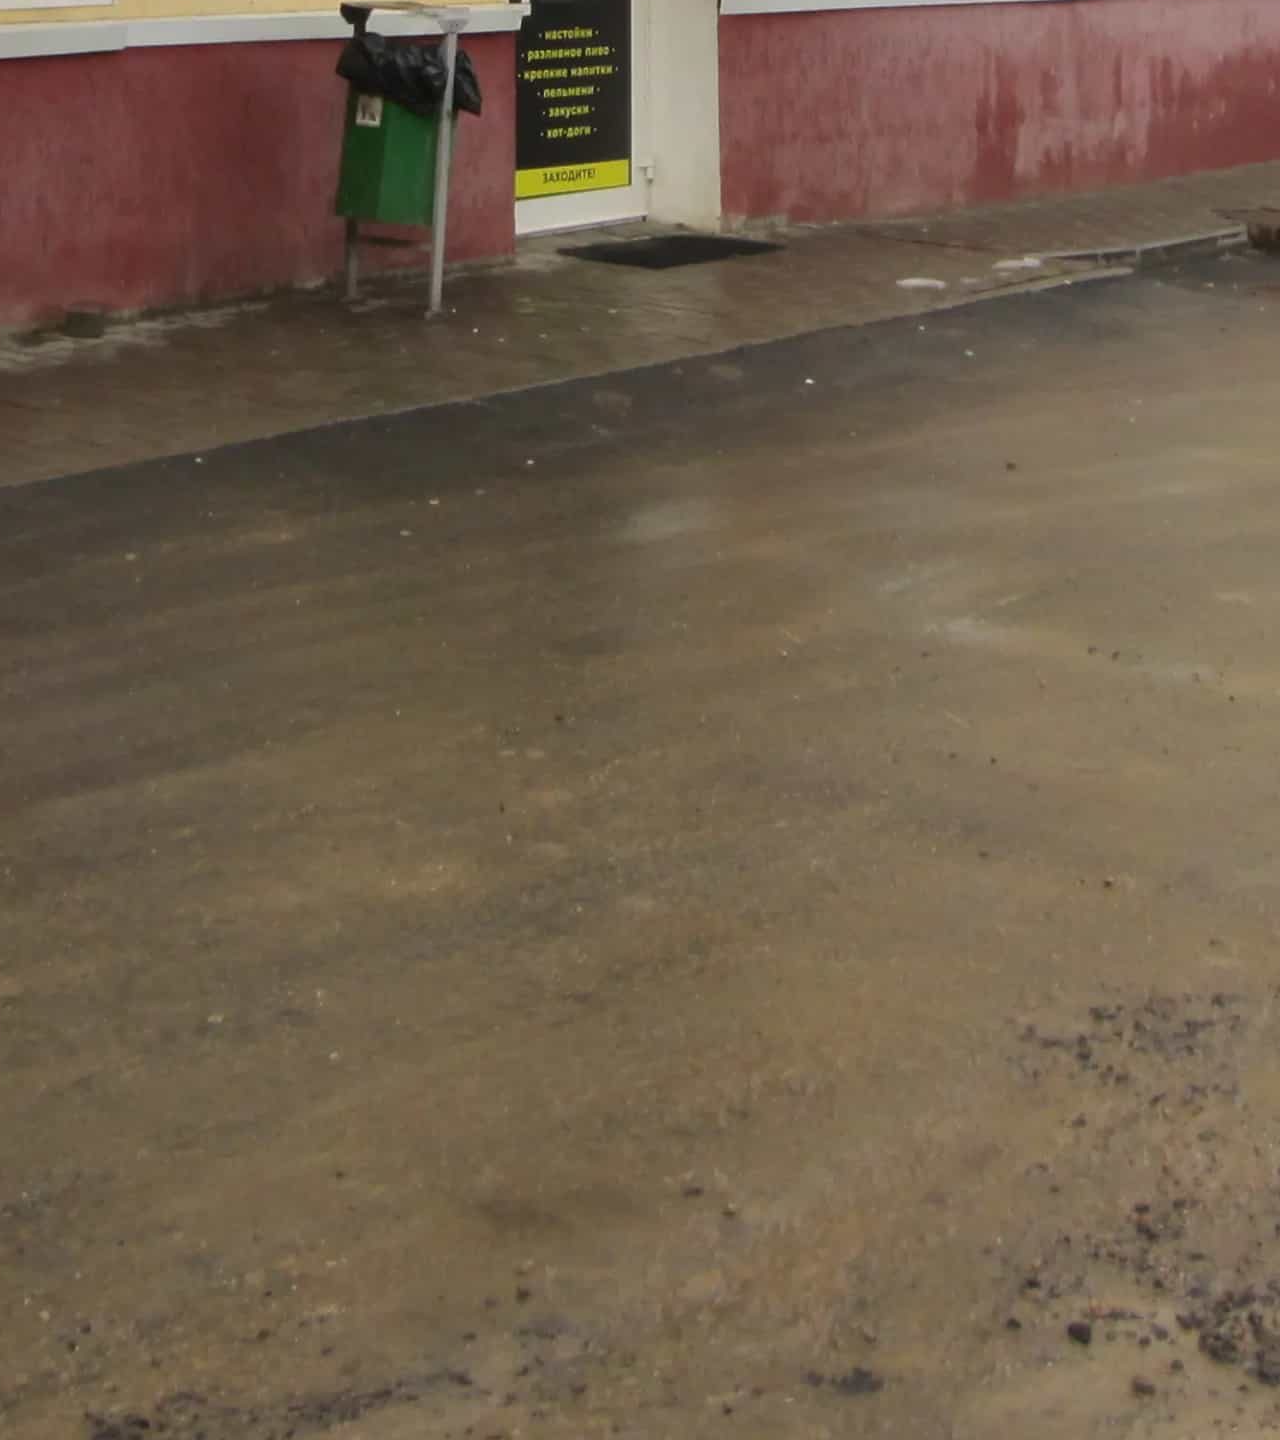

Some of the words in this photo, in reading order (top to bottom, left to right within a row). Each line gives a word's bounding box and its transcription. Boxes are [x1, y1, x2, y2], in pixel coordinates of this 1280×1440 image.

[544, 26, 593, 41] настойки
[527, 48, 582, 62] разливное
[584, 45, 610, 57] пиво
[523, 68, 568, 82] крепкие
[570, 65, 613, 78] напитки
[543, 85, 595, 99] пельмени
[548, 104, 590, 119] закуски
[546, 125, 592, 139] хот-доги
[542, 168, 596, 184] ЗАХОДИТЕ!
